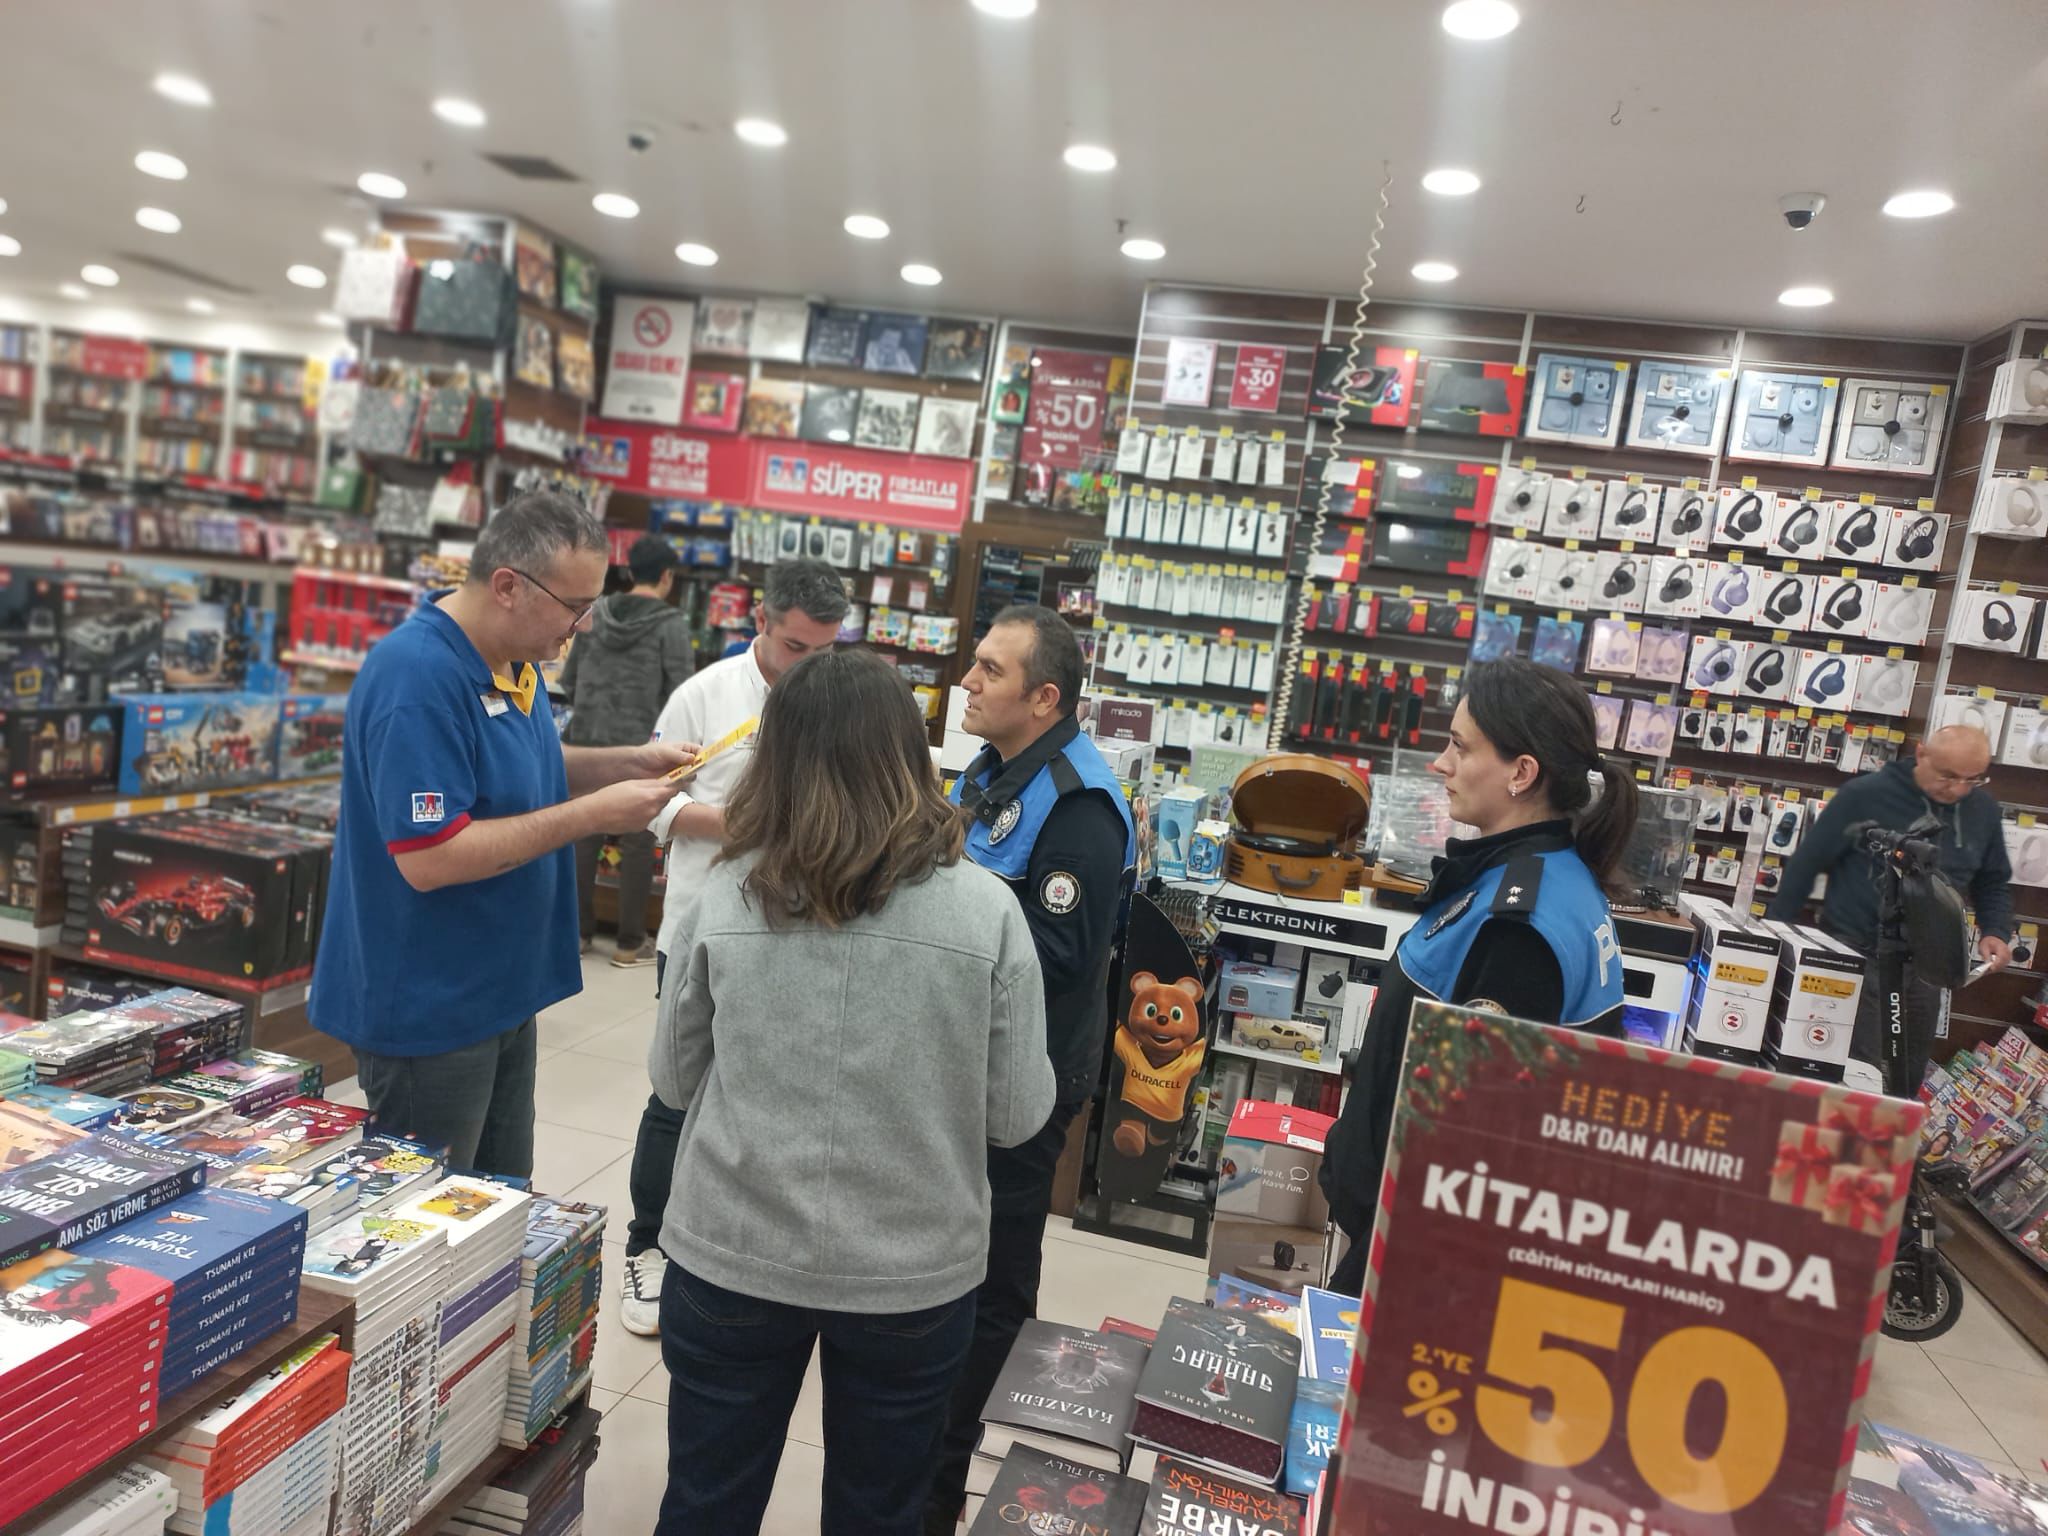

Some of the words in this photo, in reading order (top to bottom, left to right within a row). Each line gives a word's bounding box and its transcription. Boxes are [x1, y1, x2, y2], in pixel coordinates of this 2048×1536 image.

[1248, 367, 1276, 387] 30
[1050, 393, 1097, 430] 50
[650, 435, 710, 466] SÜPER
[811, 462, 883, 501] SÜPER
[889, 476, 958, 497] FIRSATLAR
[1213, 903, 1338, 936] ELEKTRONİK
[1130, 1067, 1182, 1090] DURACELL
[1560, 1081, 1733, 1148] HEDİYE
[50, 1152, 150, 1187] VERME
[1651, 1136, 1744, 1181] ALINIR!
[34, 1173, 100, 1197] SÖZ
[86, 1212, 108, 1236] SÖZ
[111, 1193, 148, 1224] VERME
[107, 1232, 199, 1260] TSUNAMİ
[154, 1230, 193, 1245] KIZ
[1422, 1162, 1837, 1309] KİTAPLARDA
[205, 1253, 242, 1281] TSUNAMİ
[242, 1246, 257, 1261] KIZ
[1507, 1245, 1572, 1280] (EĞİTİM
[1574, 1259, 1661, 1297] KİTAPLARI
[1663, 1283, 1725, 1315] HARİÇ)
[201, 1277, 238, 1305] TSUNAMİ
[238, 1270, 253, 1286] KIZ
[198, 1301, 235, 1330] TSUNAMİ
[235, 1294, 251, 1309] KIZ
[195, 1325, 231, 1354] TSUNAMİ
[232, 1317, 247, 1333] KIZ
[191, 1349, 228, 1379] TSUNAMİ
[229, 1341, 244, 1356] KIZ
[1008, 1389, 1114, 1425] KAZAZEDE
[1403, 1371, 1463, 1436] %
[1475, 1276, 1788, 1514] 50
[1044, 1458, 1084, 1476] TILLY
[1170, 1468, 1282, 1514] HAMILTON
[1186, 1483, 1291, 1531] LAURELL
